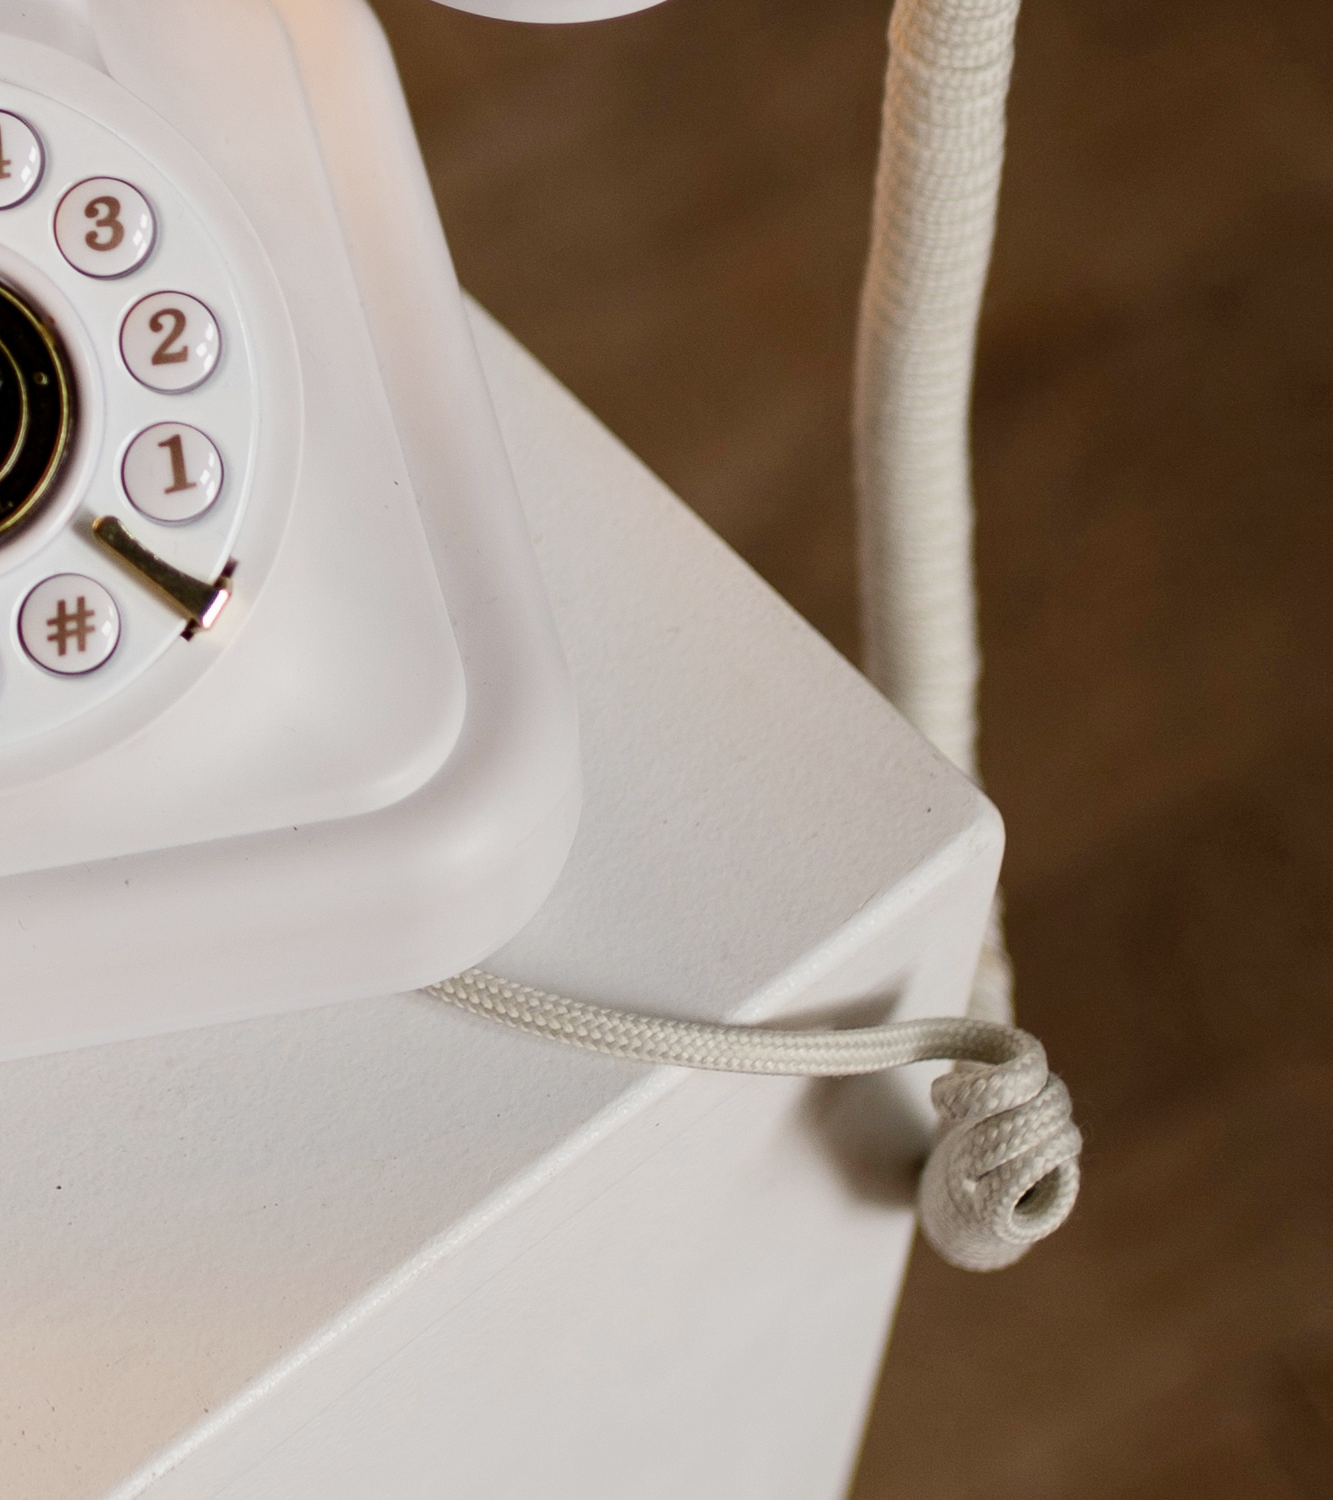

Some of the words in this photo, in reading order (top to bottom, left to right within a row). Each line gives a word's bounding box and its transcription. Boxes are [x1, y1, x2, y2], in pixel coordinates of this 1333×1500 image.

[84, 196, 124, 252] 3
[149, 308, 188, 366] 2
[158, 434, 196, 494] 1
[46, 596, 95, 656] #
